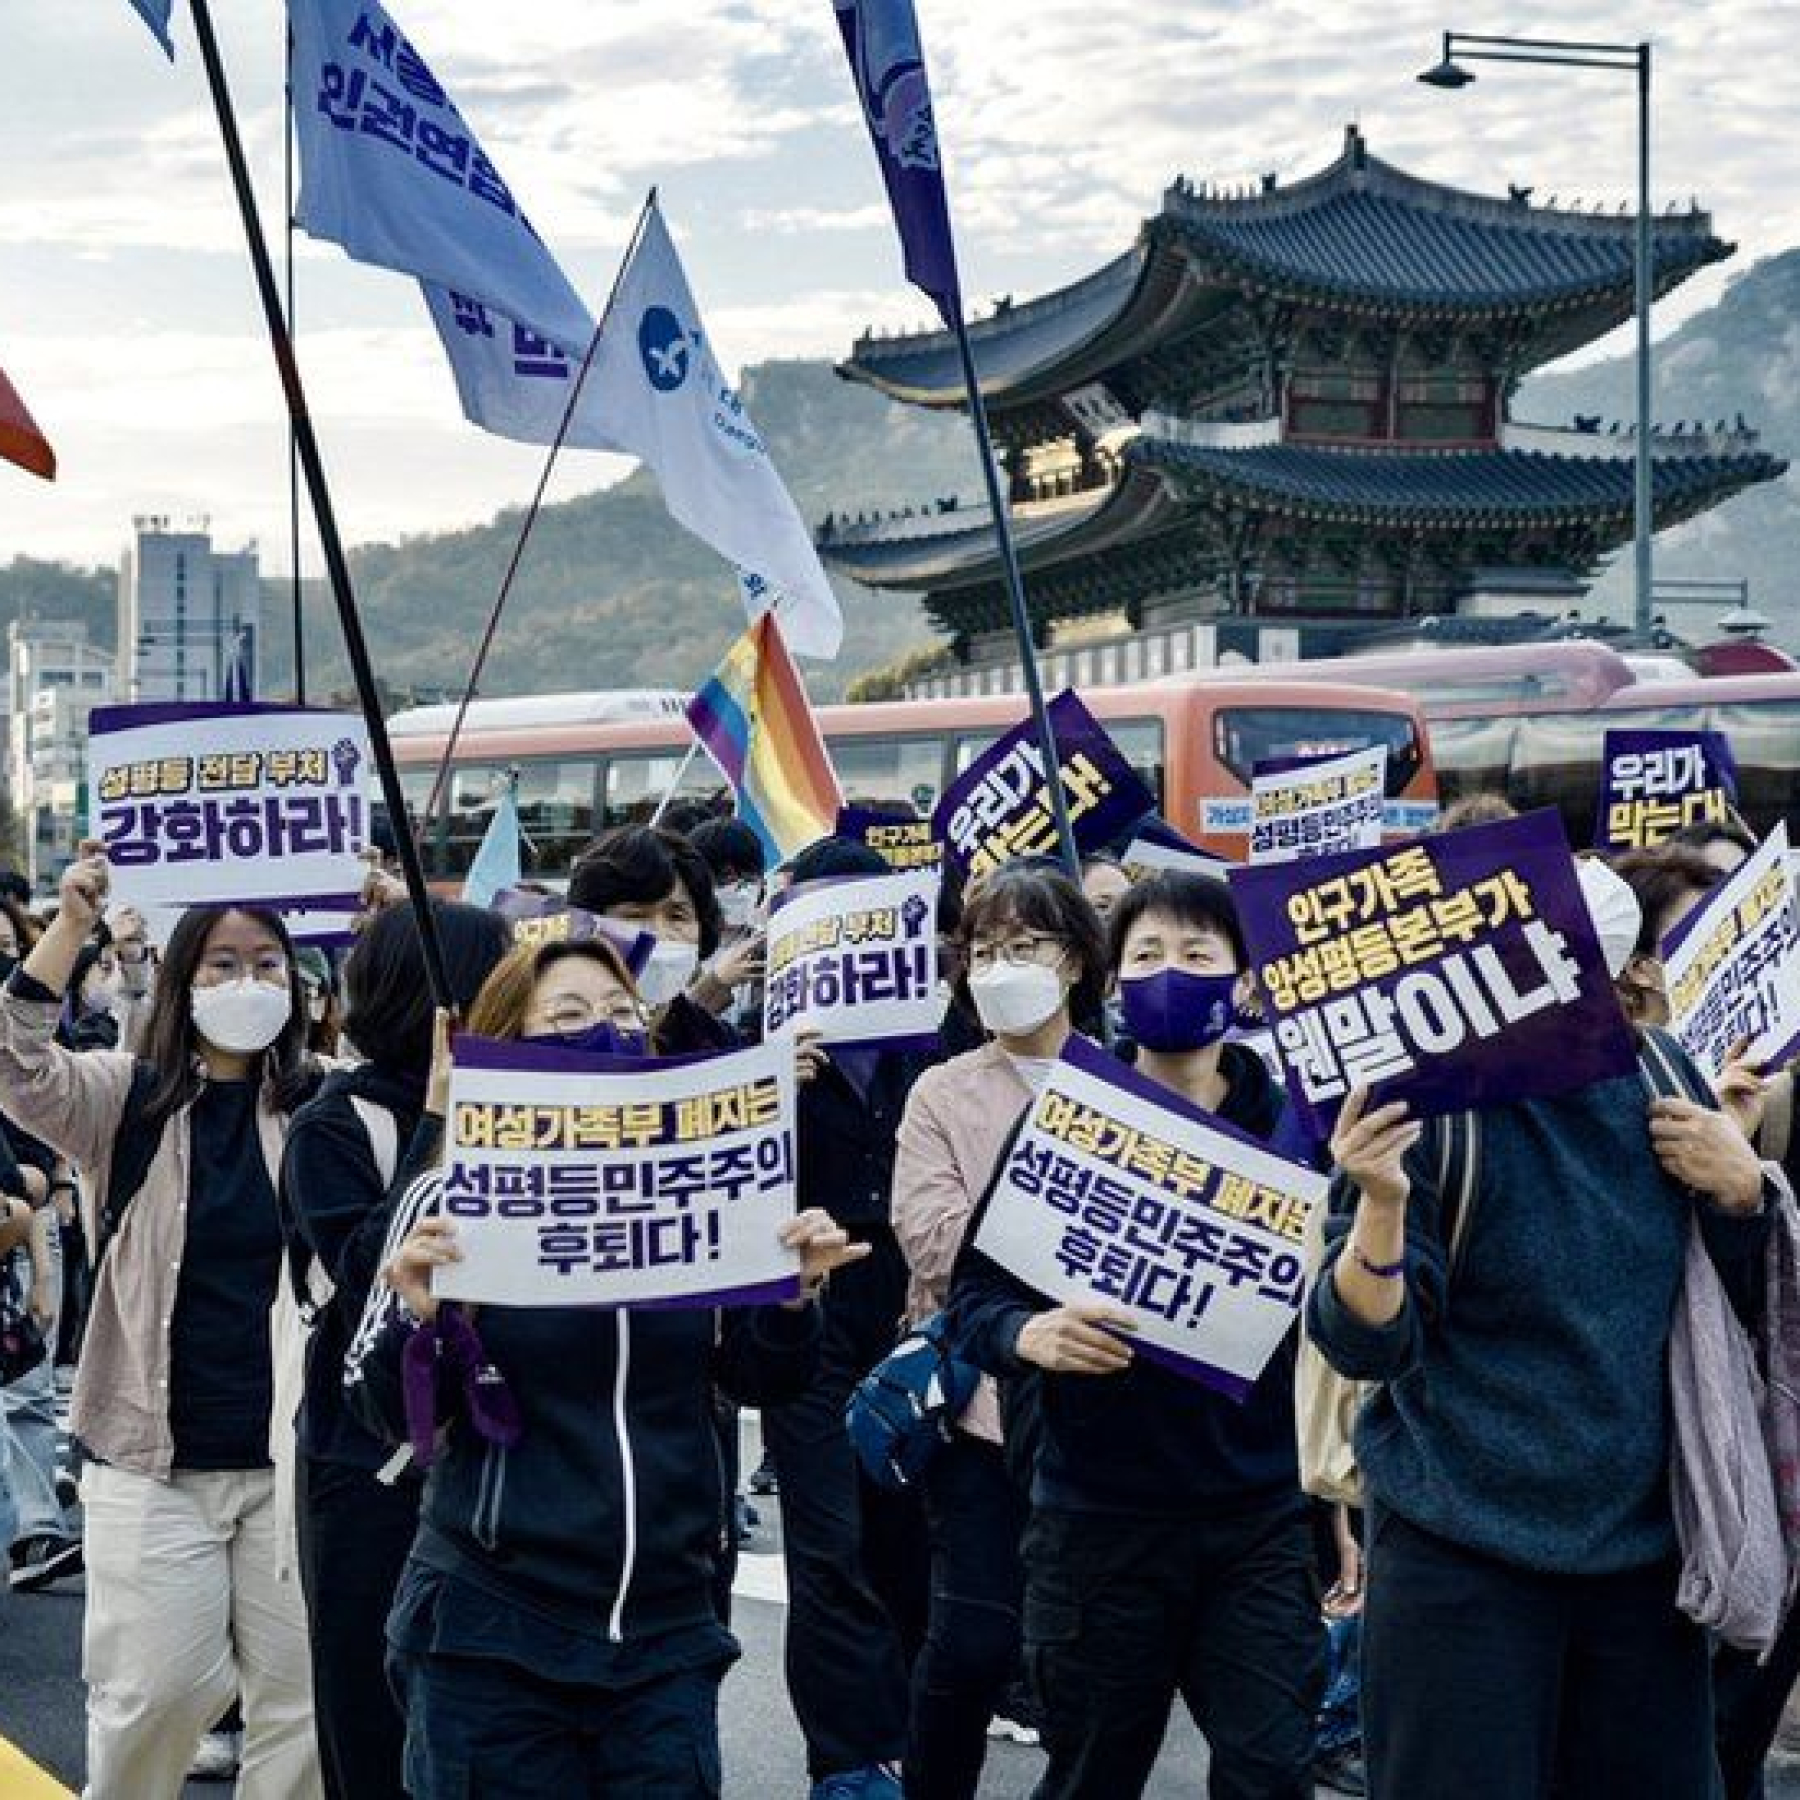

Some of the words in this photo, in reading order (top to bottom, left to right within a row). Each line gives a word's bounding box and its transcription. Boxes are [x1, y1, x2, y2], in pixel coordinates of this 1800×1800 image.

[1611, 744, 1706, 800] 우리가
[101, 796, 361, 866] 강화하라!
[1262, 869, 1534, 1011] 양성평등본부가
[1287, 846, 1443, 944] 인구가족
[1276, 919, 1582, 1102] 웬말이냐
[456, 1102, 664, 1149] 여성가족부
[676, 1076, 780, 1141] 폐지는
[1035, 1088, 1218, 1201] 여성가족부
[446, 1130, 794, 1217] 성평등민주주의
[537, 1210, 719, 1275] 후퇴다!
[1010, 1140, 1307, 1309] 성평등민주주의
[1055, 1225, 1214, 1328] 후퇴다!
